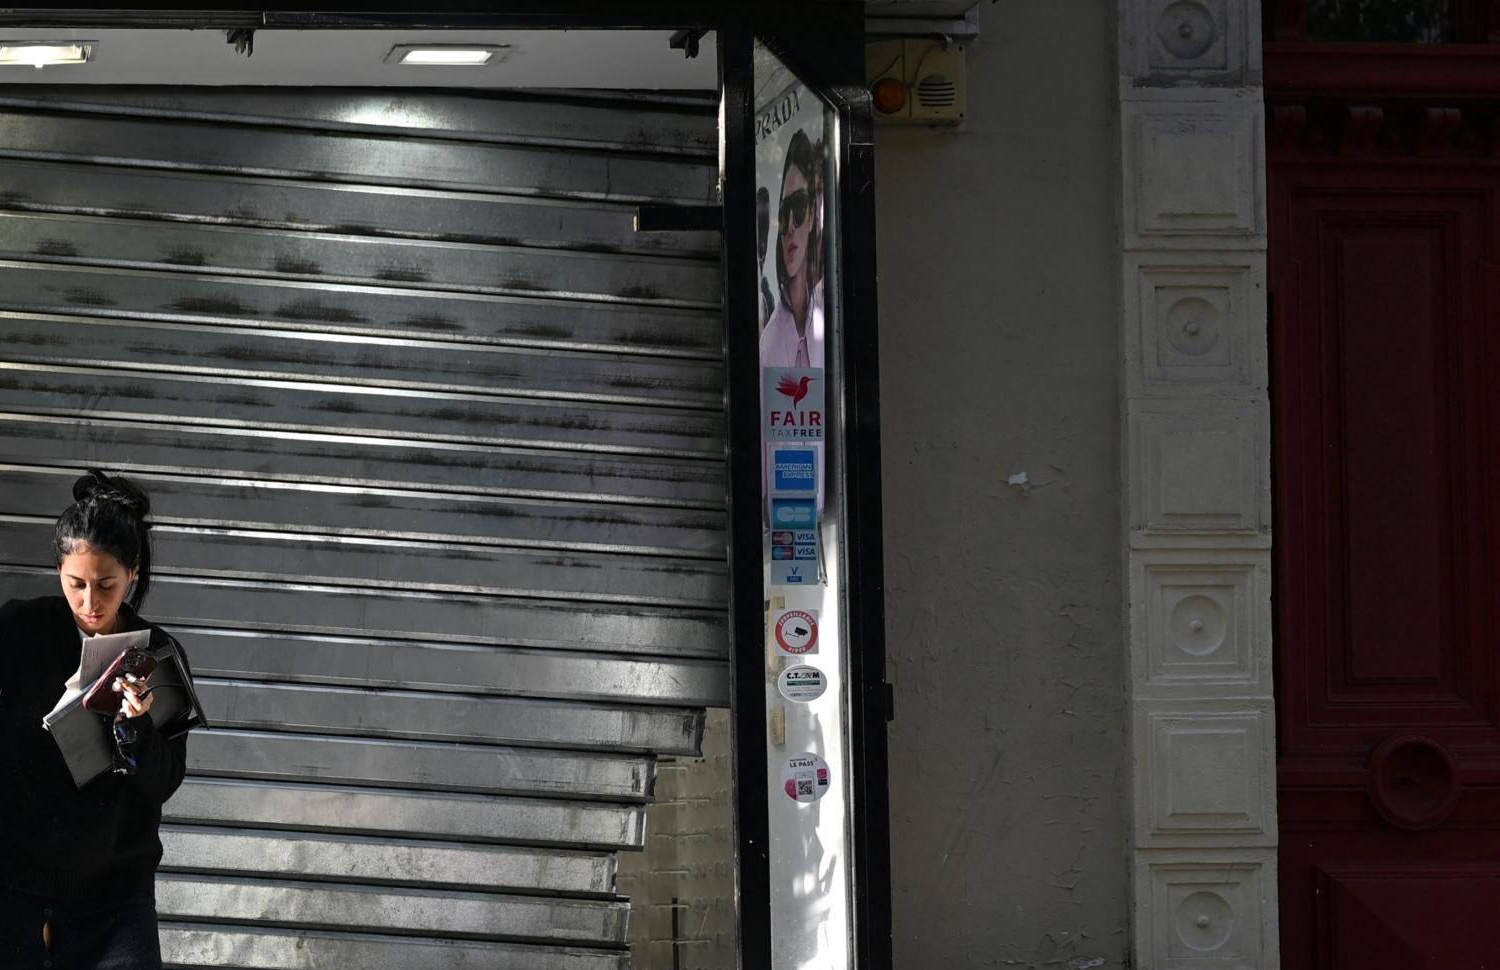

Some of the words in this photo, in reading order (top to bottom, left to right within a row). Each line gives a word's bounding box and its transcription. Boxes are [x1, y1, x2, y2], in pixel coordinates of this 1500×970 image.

[770, 410, 822, 427] FAIR
[775, 463, 813, 471] AMERICAN
[782, 471, 814, 479] EXPRESS
[777, 506, 811, 522] CB
[796, 533, 815, 541] VISA
[796, 548, 815, 556] VISA
